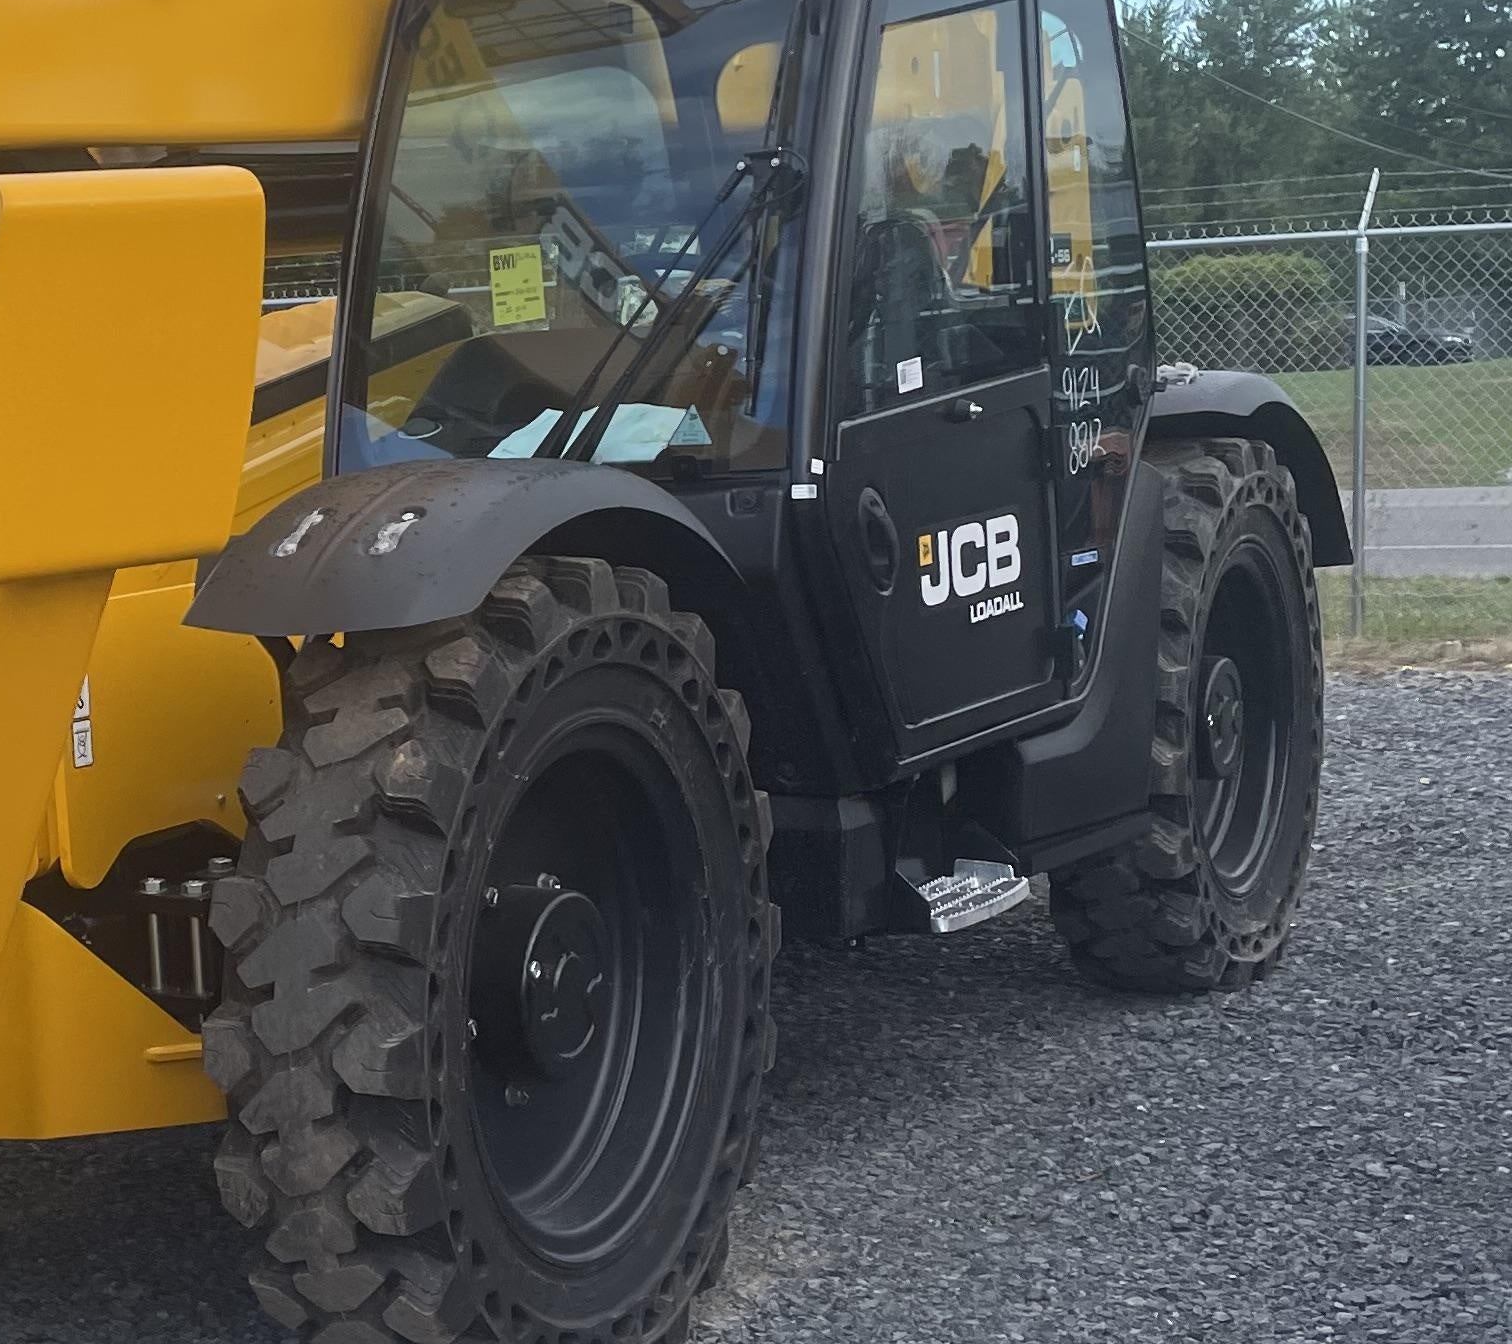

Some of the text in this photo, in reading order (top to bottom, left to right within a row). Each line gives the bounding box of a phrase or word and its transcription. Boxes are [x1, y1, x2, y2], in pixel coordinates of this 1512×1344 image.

[1062, 367, 1101, 411] 9124
[1069, 418, 1107, 475] 8812
[921, 514, 1021, 607] JCB
[970, 592, 1024, 624] LOADALL
